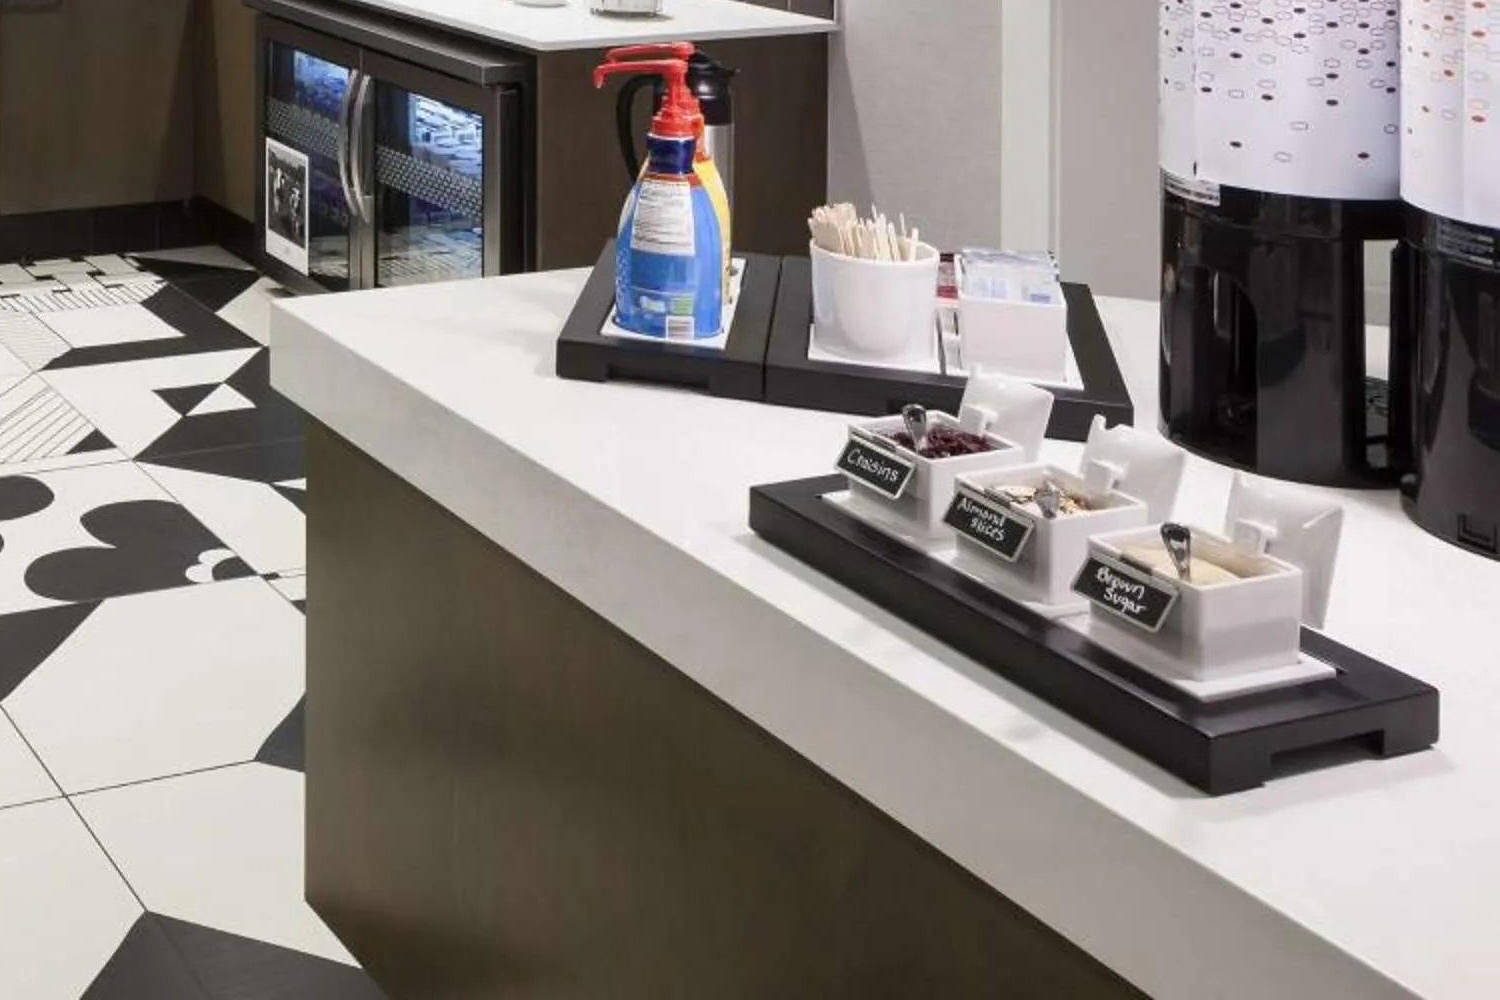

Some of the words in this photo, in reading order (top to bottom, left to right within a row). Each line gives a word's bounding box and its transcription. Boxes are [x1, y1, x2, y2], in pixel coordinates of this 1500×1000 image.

[956, 497, 1006, 527] Almond
[1094, 566, 1145, 600] Brown
[1103, 587, 1148, 614] Sugar
